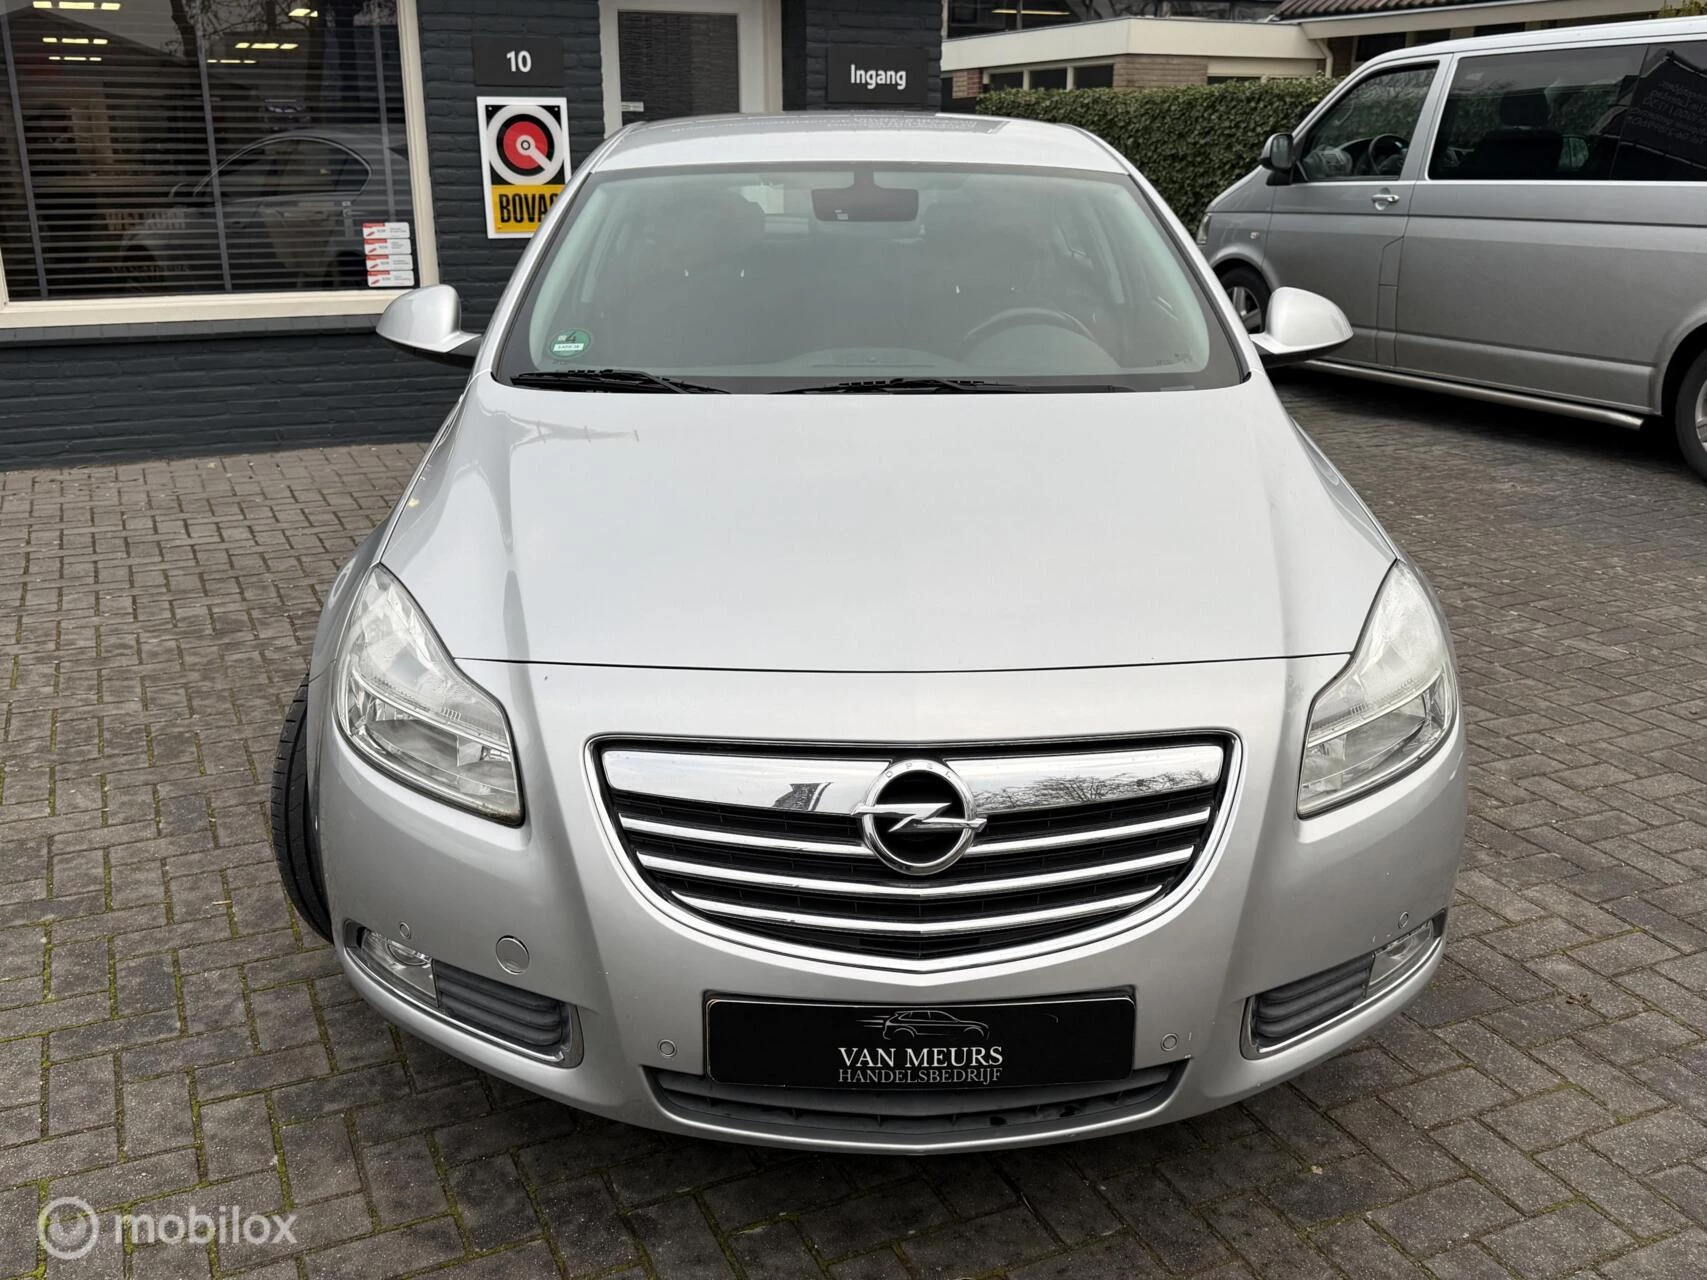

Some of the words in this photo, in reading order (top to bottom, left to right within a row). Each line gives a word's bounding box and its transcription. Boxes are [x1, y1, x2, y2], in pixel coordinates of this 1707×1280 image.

[506, 50, 532, 72] 10
[851, 64, 907, 90] Ingang
[838, 1047, 896, 1067] VAN
[904, 1046, 1003, 1067] MEURS
[838, 1067, 1003, 1085] HANDELSBEDRIJF
